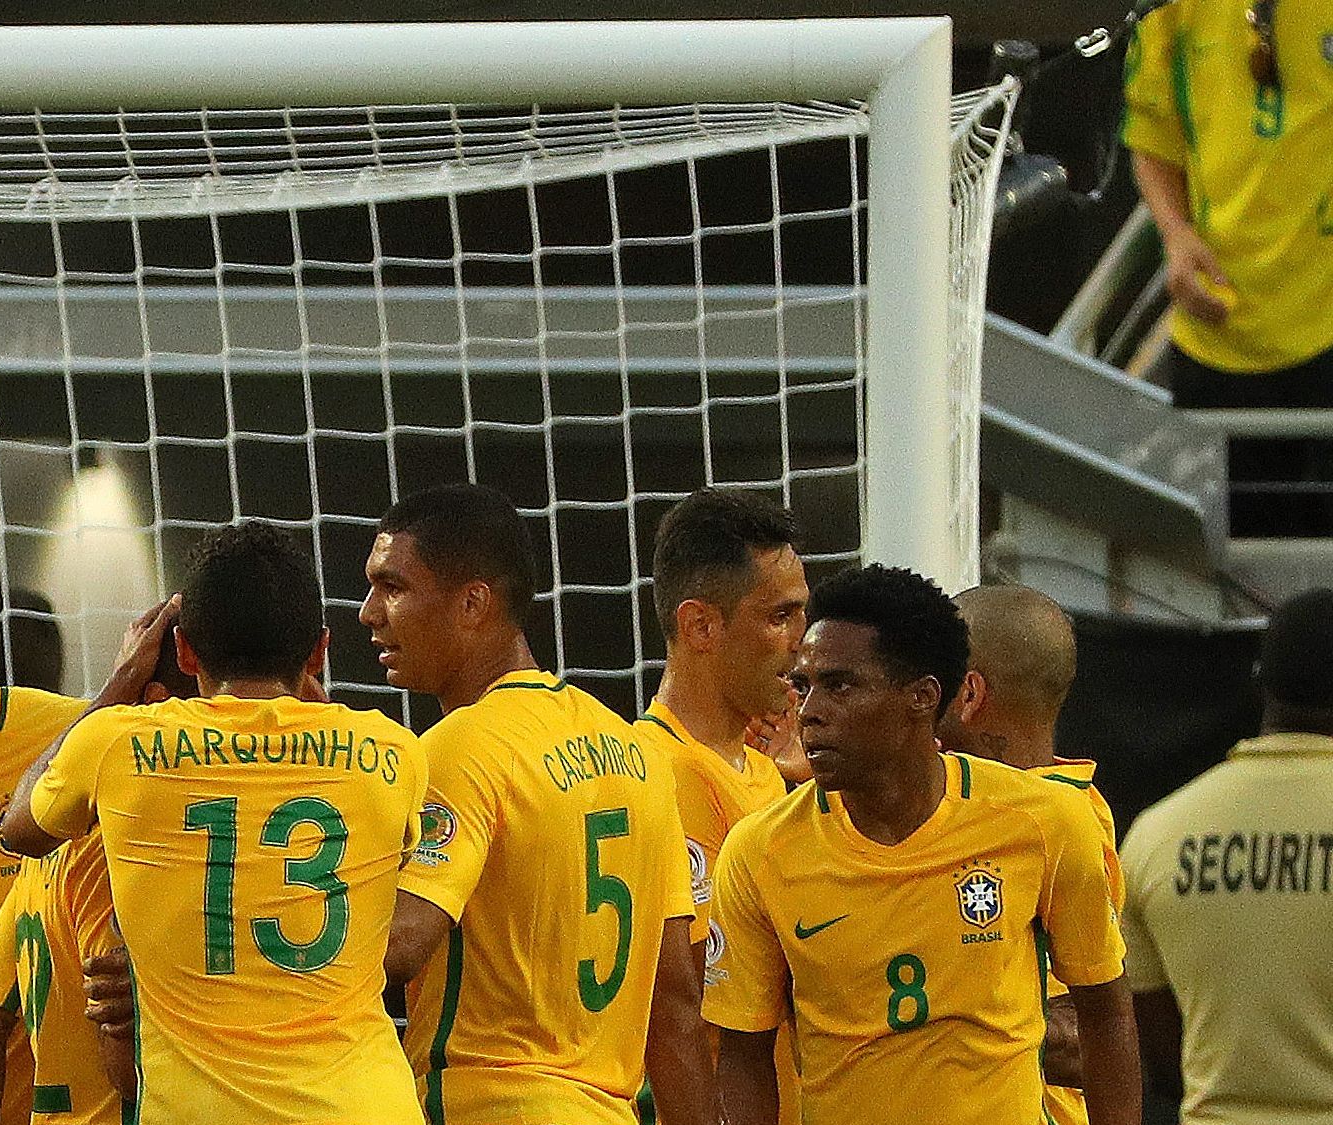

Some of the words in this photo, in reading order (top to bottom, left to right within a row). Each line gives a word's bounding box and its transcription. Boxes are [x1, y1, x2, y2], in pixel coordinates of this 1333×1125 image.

[131, 727, 399, 785] MARQUINHOS
[543, 732, 646, 793] CASEMIRO
[184, 797, 349, 975] 13
[577, 807, 634, 1013] 5
[961, 931, 1004, 945] BRASIL
[886, 953, 929, 1032] 8
